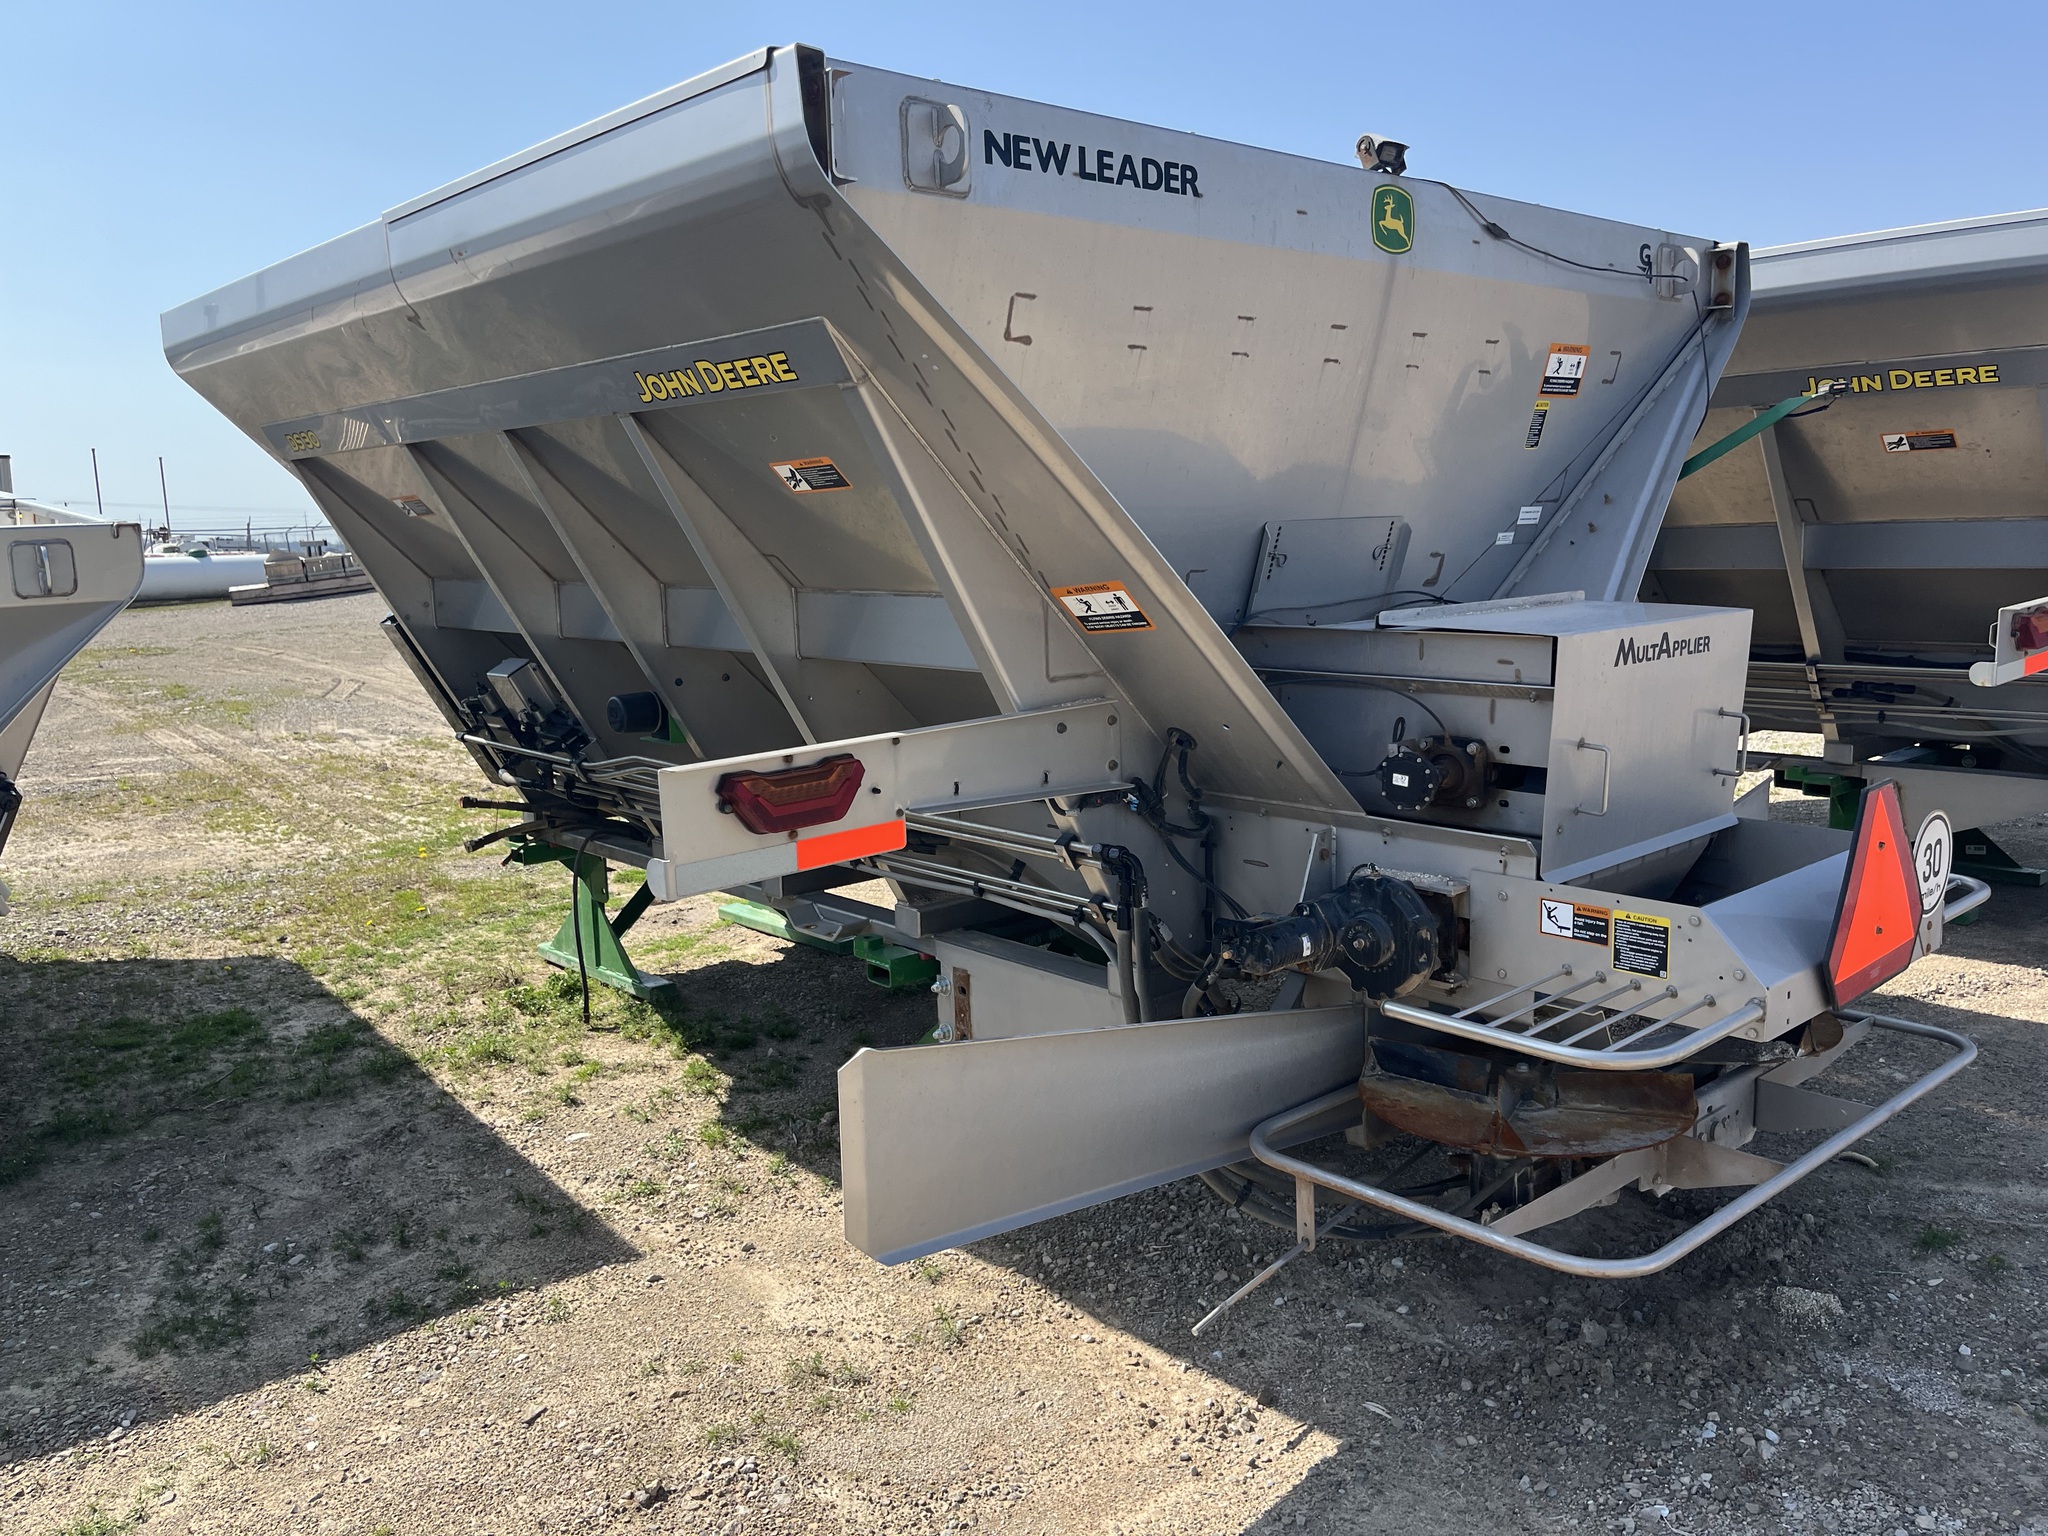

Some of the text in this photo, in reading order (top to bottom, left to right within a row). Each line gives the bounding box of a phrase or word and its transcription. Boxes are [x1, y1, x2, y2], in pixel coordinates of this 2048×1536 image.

[983, 129, 1202, 198] NEW LEADER
[633, 350, 799, 403] JOHN DEERE
[1888, 365, 2000, 391] DEERE
[1073, 583, 1110, 594] WARNING
[1922, 838, 1942, 884] 30
[1581, 906, 1608, 916] WARNING
[1632, 915, 1658, 924] CAUTION
